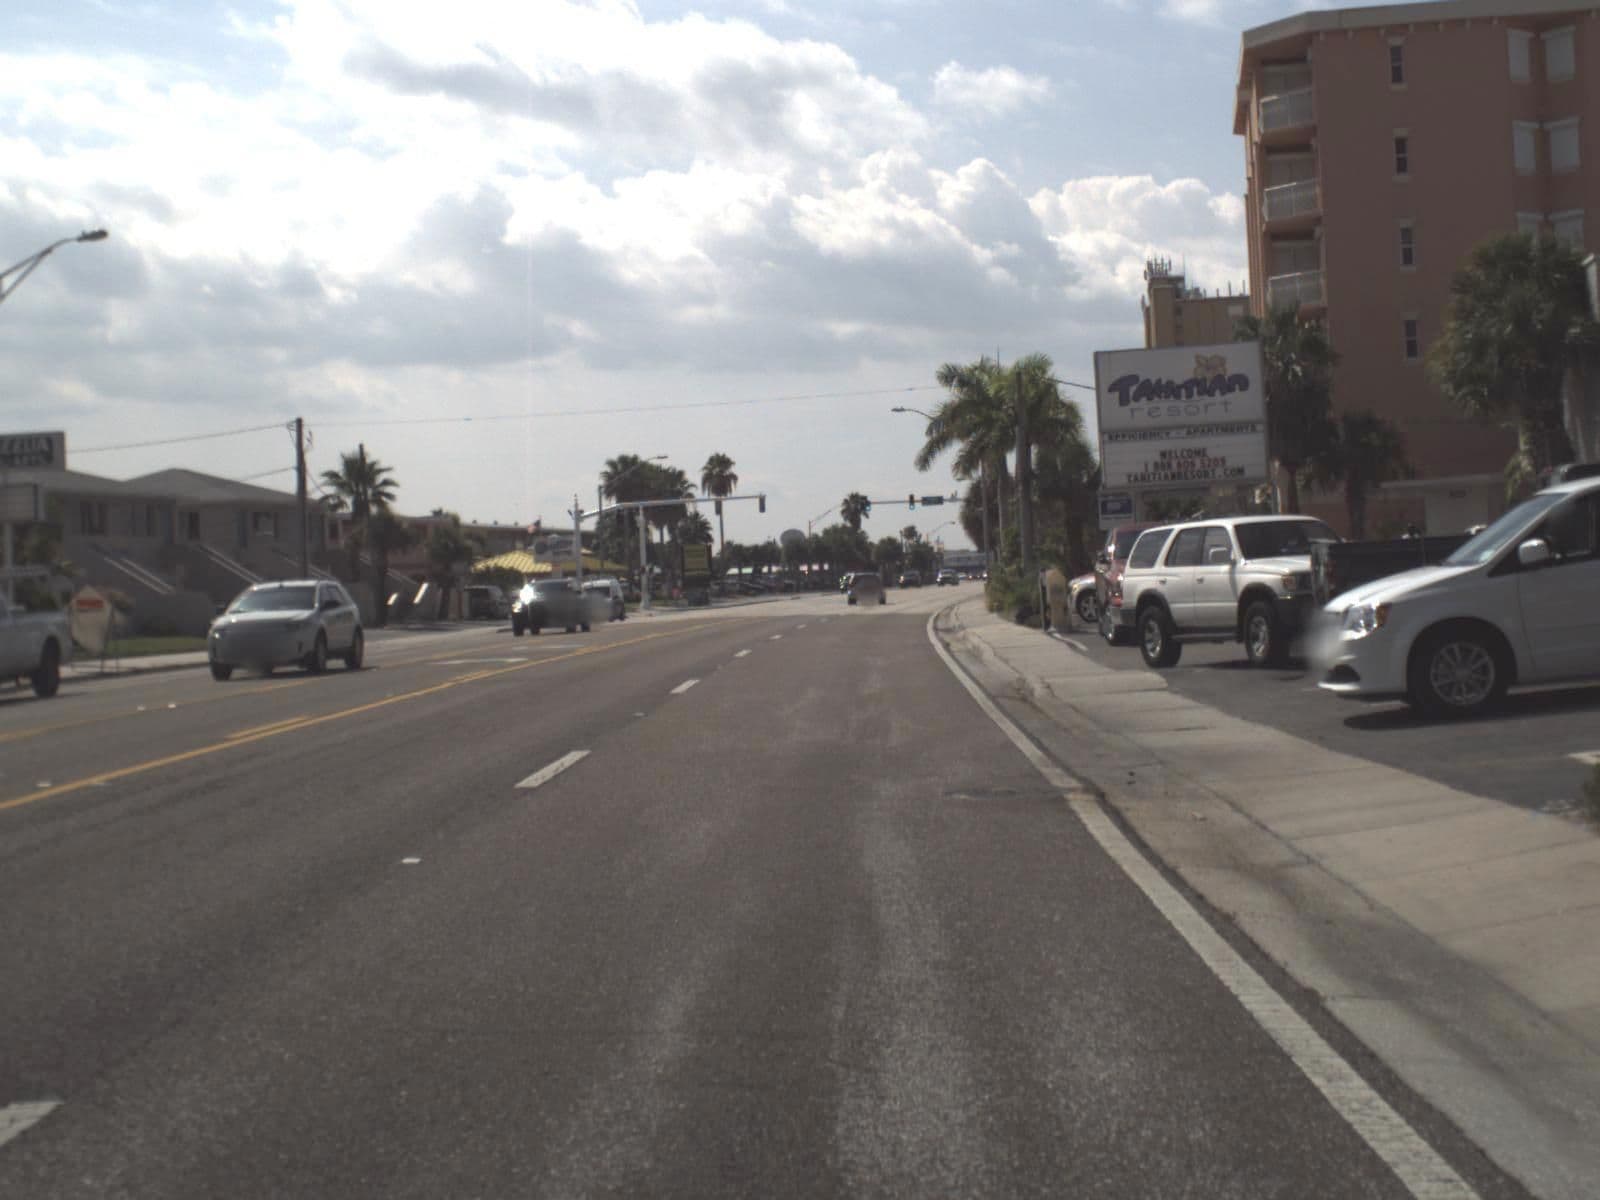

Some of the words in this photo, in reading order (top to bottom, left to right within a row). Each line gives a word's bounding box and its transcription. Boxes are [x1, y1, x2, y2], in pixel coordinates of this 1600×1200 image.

[1130, 401, 1232, 420] resort
[1159, 448, 1207, 460] WELCOME
[1126, 467, 1245, 483] TAHITIANRESORT.COM
